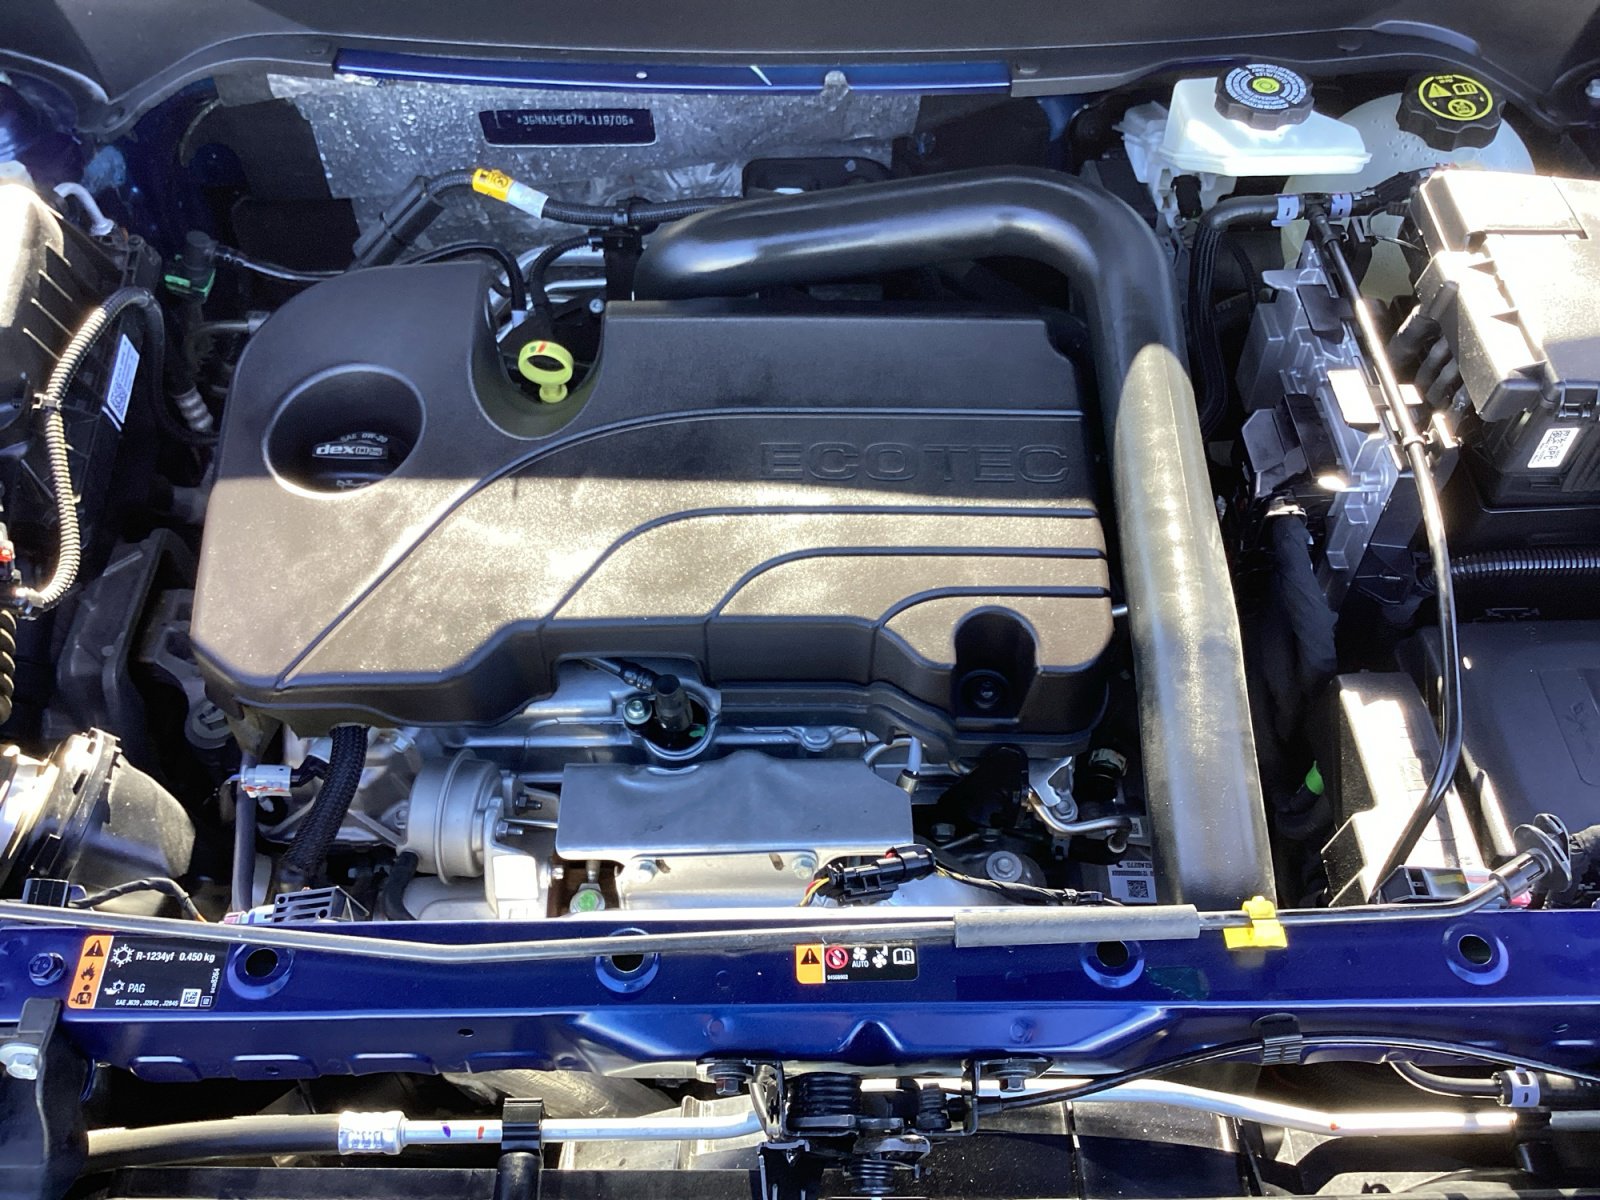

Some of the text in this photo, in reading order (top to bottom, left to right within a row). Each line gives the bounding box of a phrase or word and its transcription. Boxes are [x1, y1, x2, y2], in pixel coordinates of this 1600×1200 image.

[316, 444, 383, 456] dexos
[760, 441, 1069, 483] ECOTEC
[135, 951, 216, 963] R-1234yf 0.450 kg
[851, 960, 869, 968] AUTO
[127, 983, 146, 993] PAG
